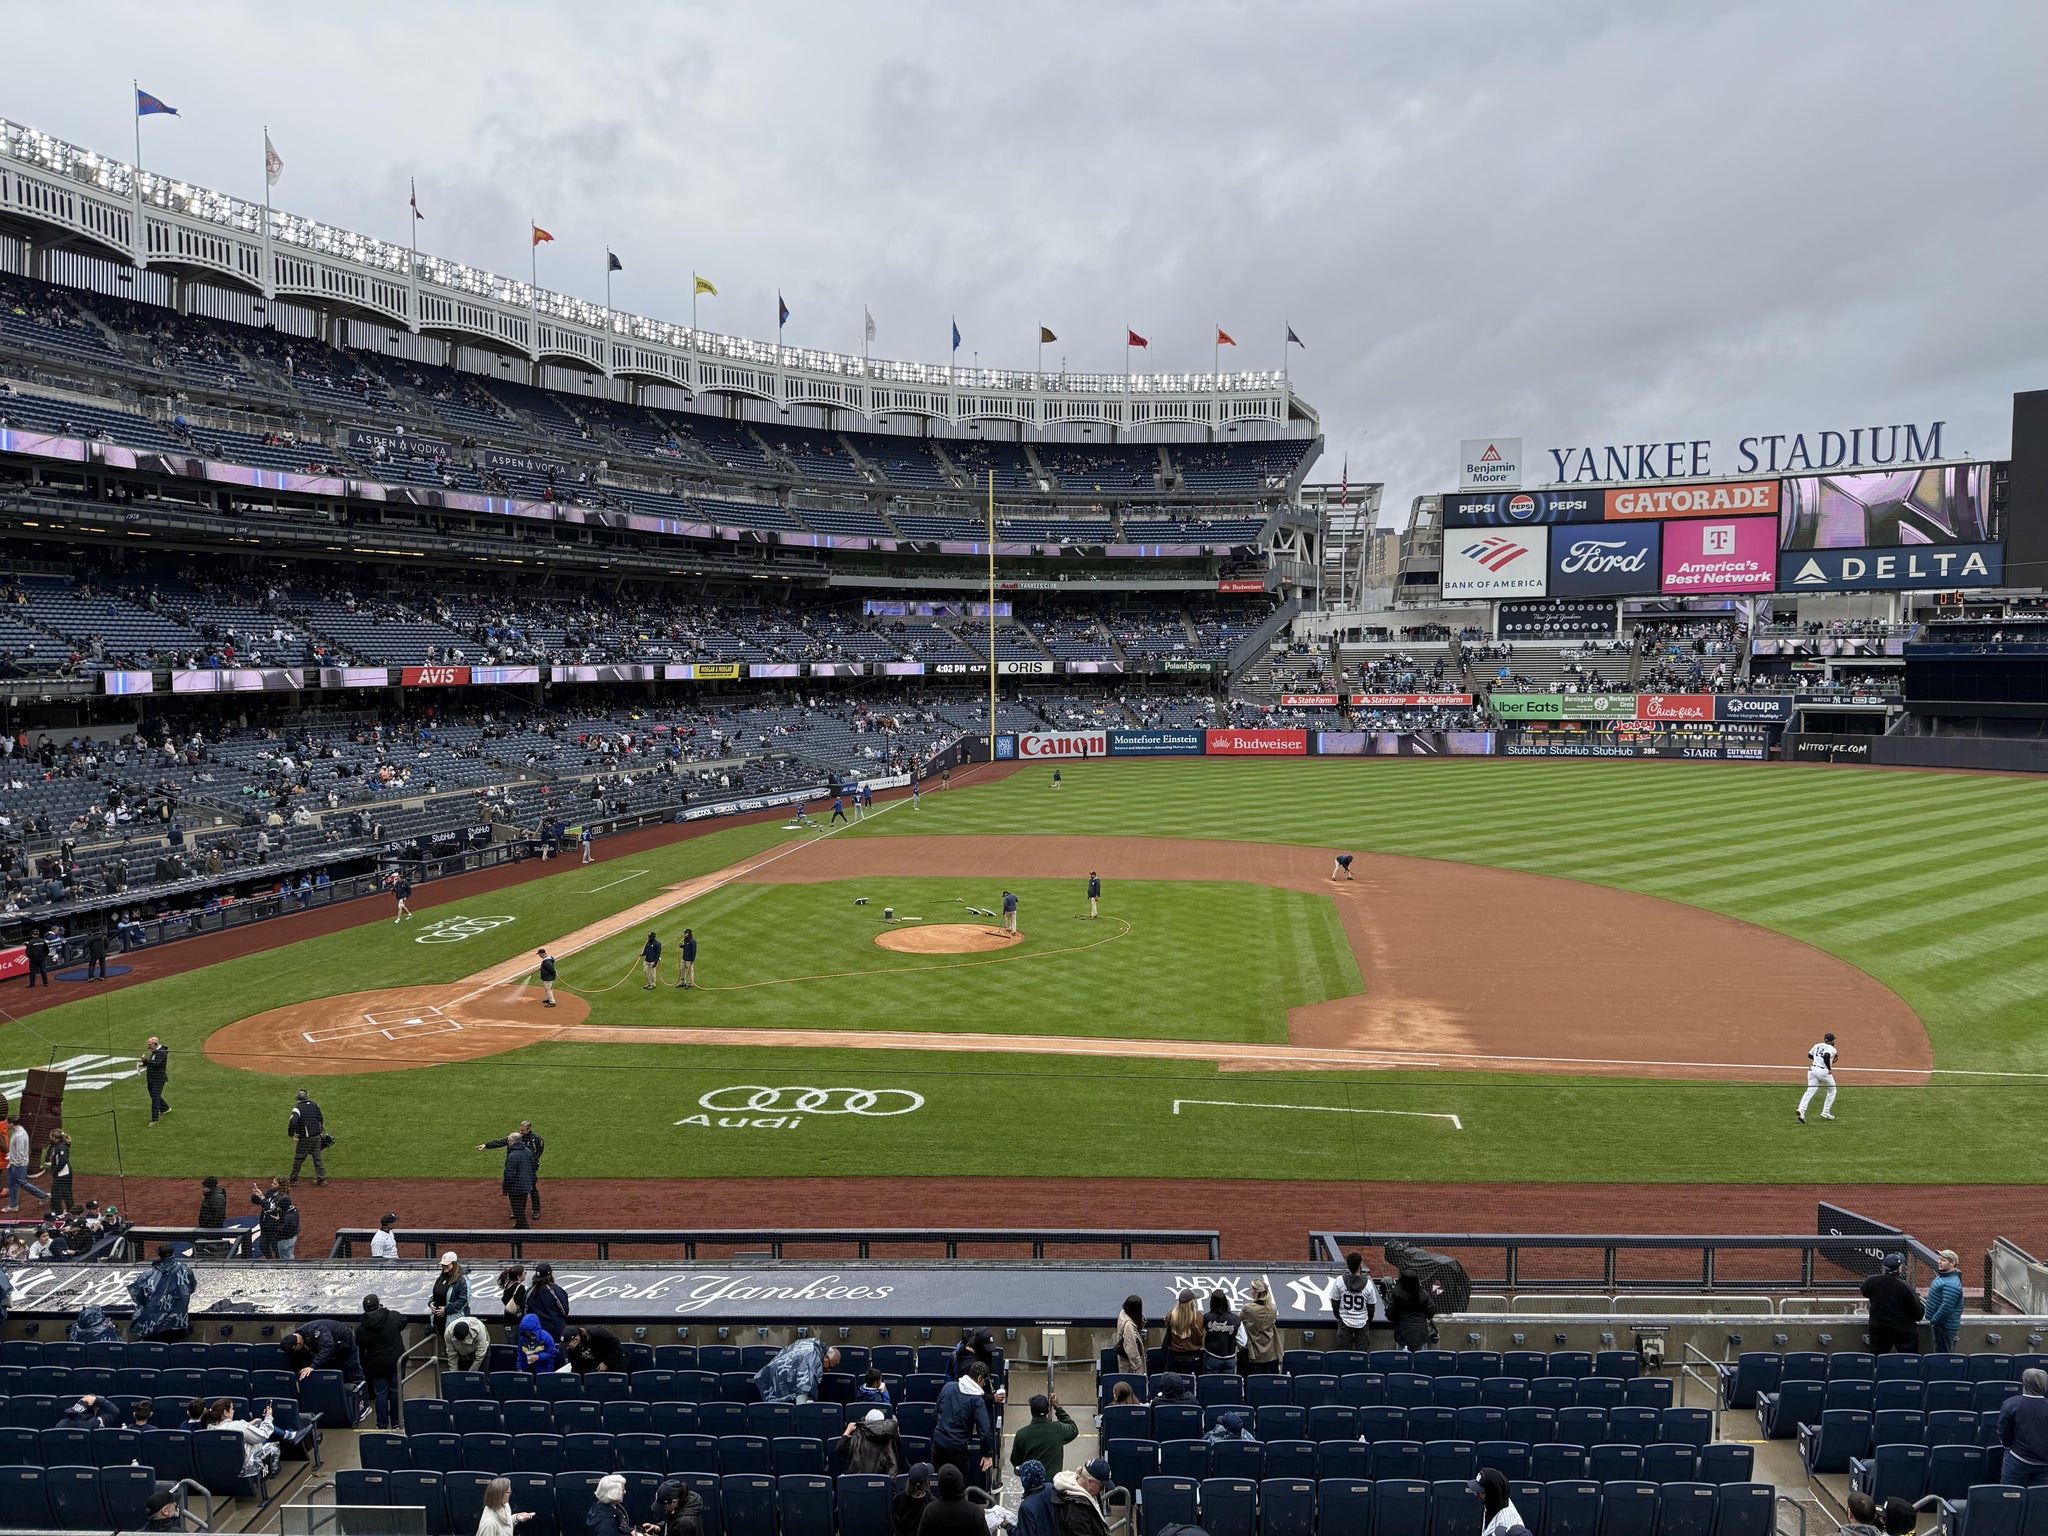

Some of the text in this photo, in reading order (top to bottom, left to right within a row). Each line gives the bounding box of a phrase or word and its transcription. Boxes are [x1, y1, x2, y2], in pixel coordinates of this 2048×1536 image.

[357, 434, 446, 457] ASPEN VODKA
[1548, 420, 1946, 484] YANKEE STADIUM
[491, 455, 524, 468] ASPEN
[1467, 463, 1515, 476] Benjamin
[1473, 473, 1506, 482] Moore
[1550, 500, 1587, 511] PEPSI
[1615, 486, 1769, 514] GATORADE
[1459, 502, 1495, 514] PEPSI
[1511, 503, 1533, 511] PEPSI
[1561, 540, 1648, 573] Ford
[1679, 560, 1758, 574] America's
[1842, 552, 1988, 580] DELTA
[1493, 579, 1543, 588] AMERICA
[1665, 571, 1772, 585] Best Network
[1232, 583, 1262, 591] Budweiser
[1940, 593, 1964, 605] 0:15
[936, 664, 953, 673] 4:02
[954, 664, 966, 673] PM
[1008, 662, 1043, 673] ORIS
[1164, 661, 1211, 672] Poland Spring
[417, 668, 455, 684] AVIS
[1527, 701, 1559, 713] Eats
[1744, 701, 1779, 713] coupa
[1020, 735, 1104, 755] Canon
[1115, 734, 1197, 744] Montefiore Einstein
[1508, 746, 1546, 755] StubHub
[1550, 746, 1589, 756] StubHub
[1593, 747, 1633, 756] StubHub
[1643, 747, 1656, 755] 399
[1683, 748, 1717, 758] STARR
[1727, 748, 1762, 756] CUTWATER
[431, 832, 456, 843] StubHub
[1815, 1046, 1825, 1058] 14
[673, 1114, 803, 1129] Audi
[1174, 1276, 1241, 1288] NEW
[676, 1274, 894, 1314] Yankees
[1343, 1294, 1365, 1311] 99
